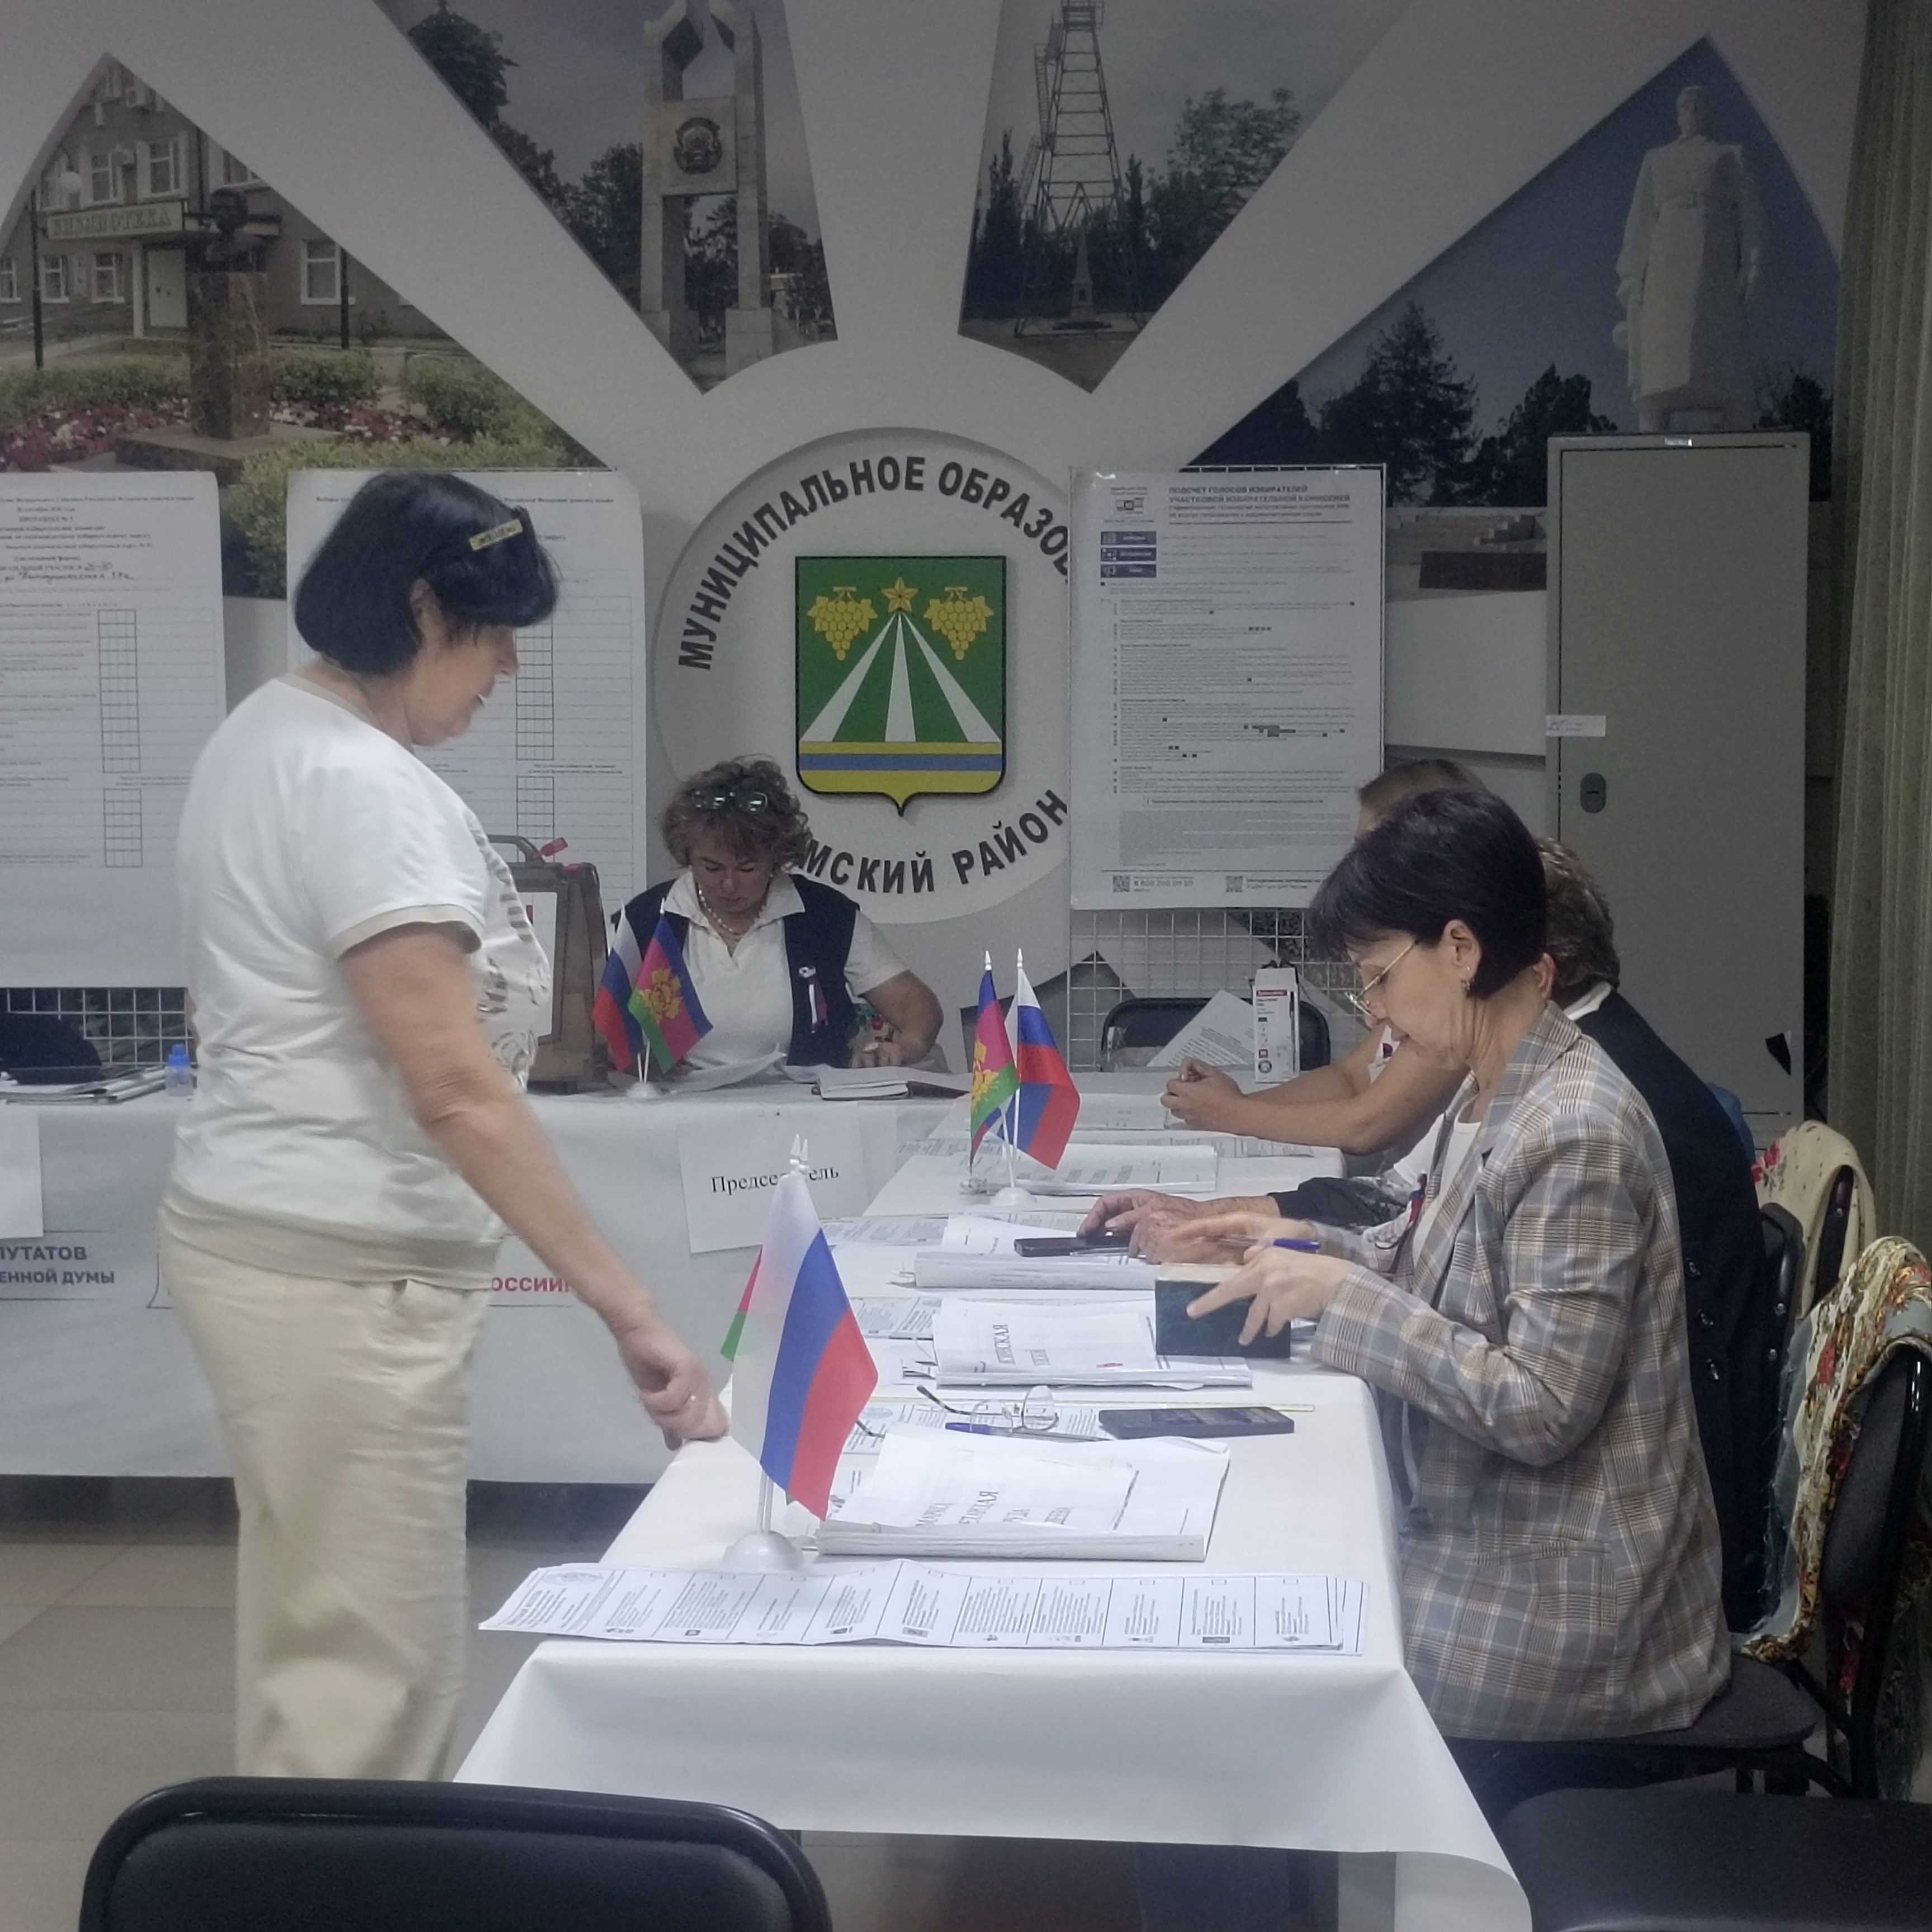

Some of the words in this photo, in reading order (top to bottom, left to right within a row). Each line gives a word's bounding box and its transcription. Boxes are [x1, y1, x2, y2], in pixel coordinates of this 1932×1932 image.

[678, 456, 925, 670] МУНИЦИПАЛЬНОЕ
[799, 839, 935, 894] МСКИЙ
[952, 789, 1067, 884] РАЙОН
[712, 1167, 839, 1195] Предсеель
[62, 1271, 115, 1285] ДУМЫ
